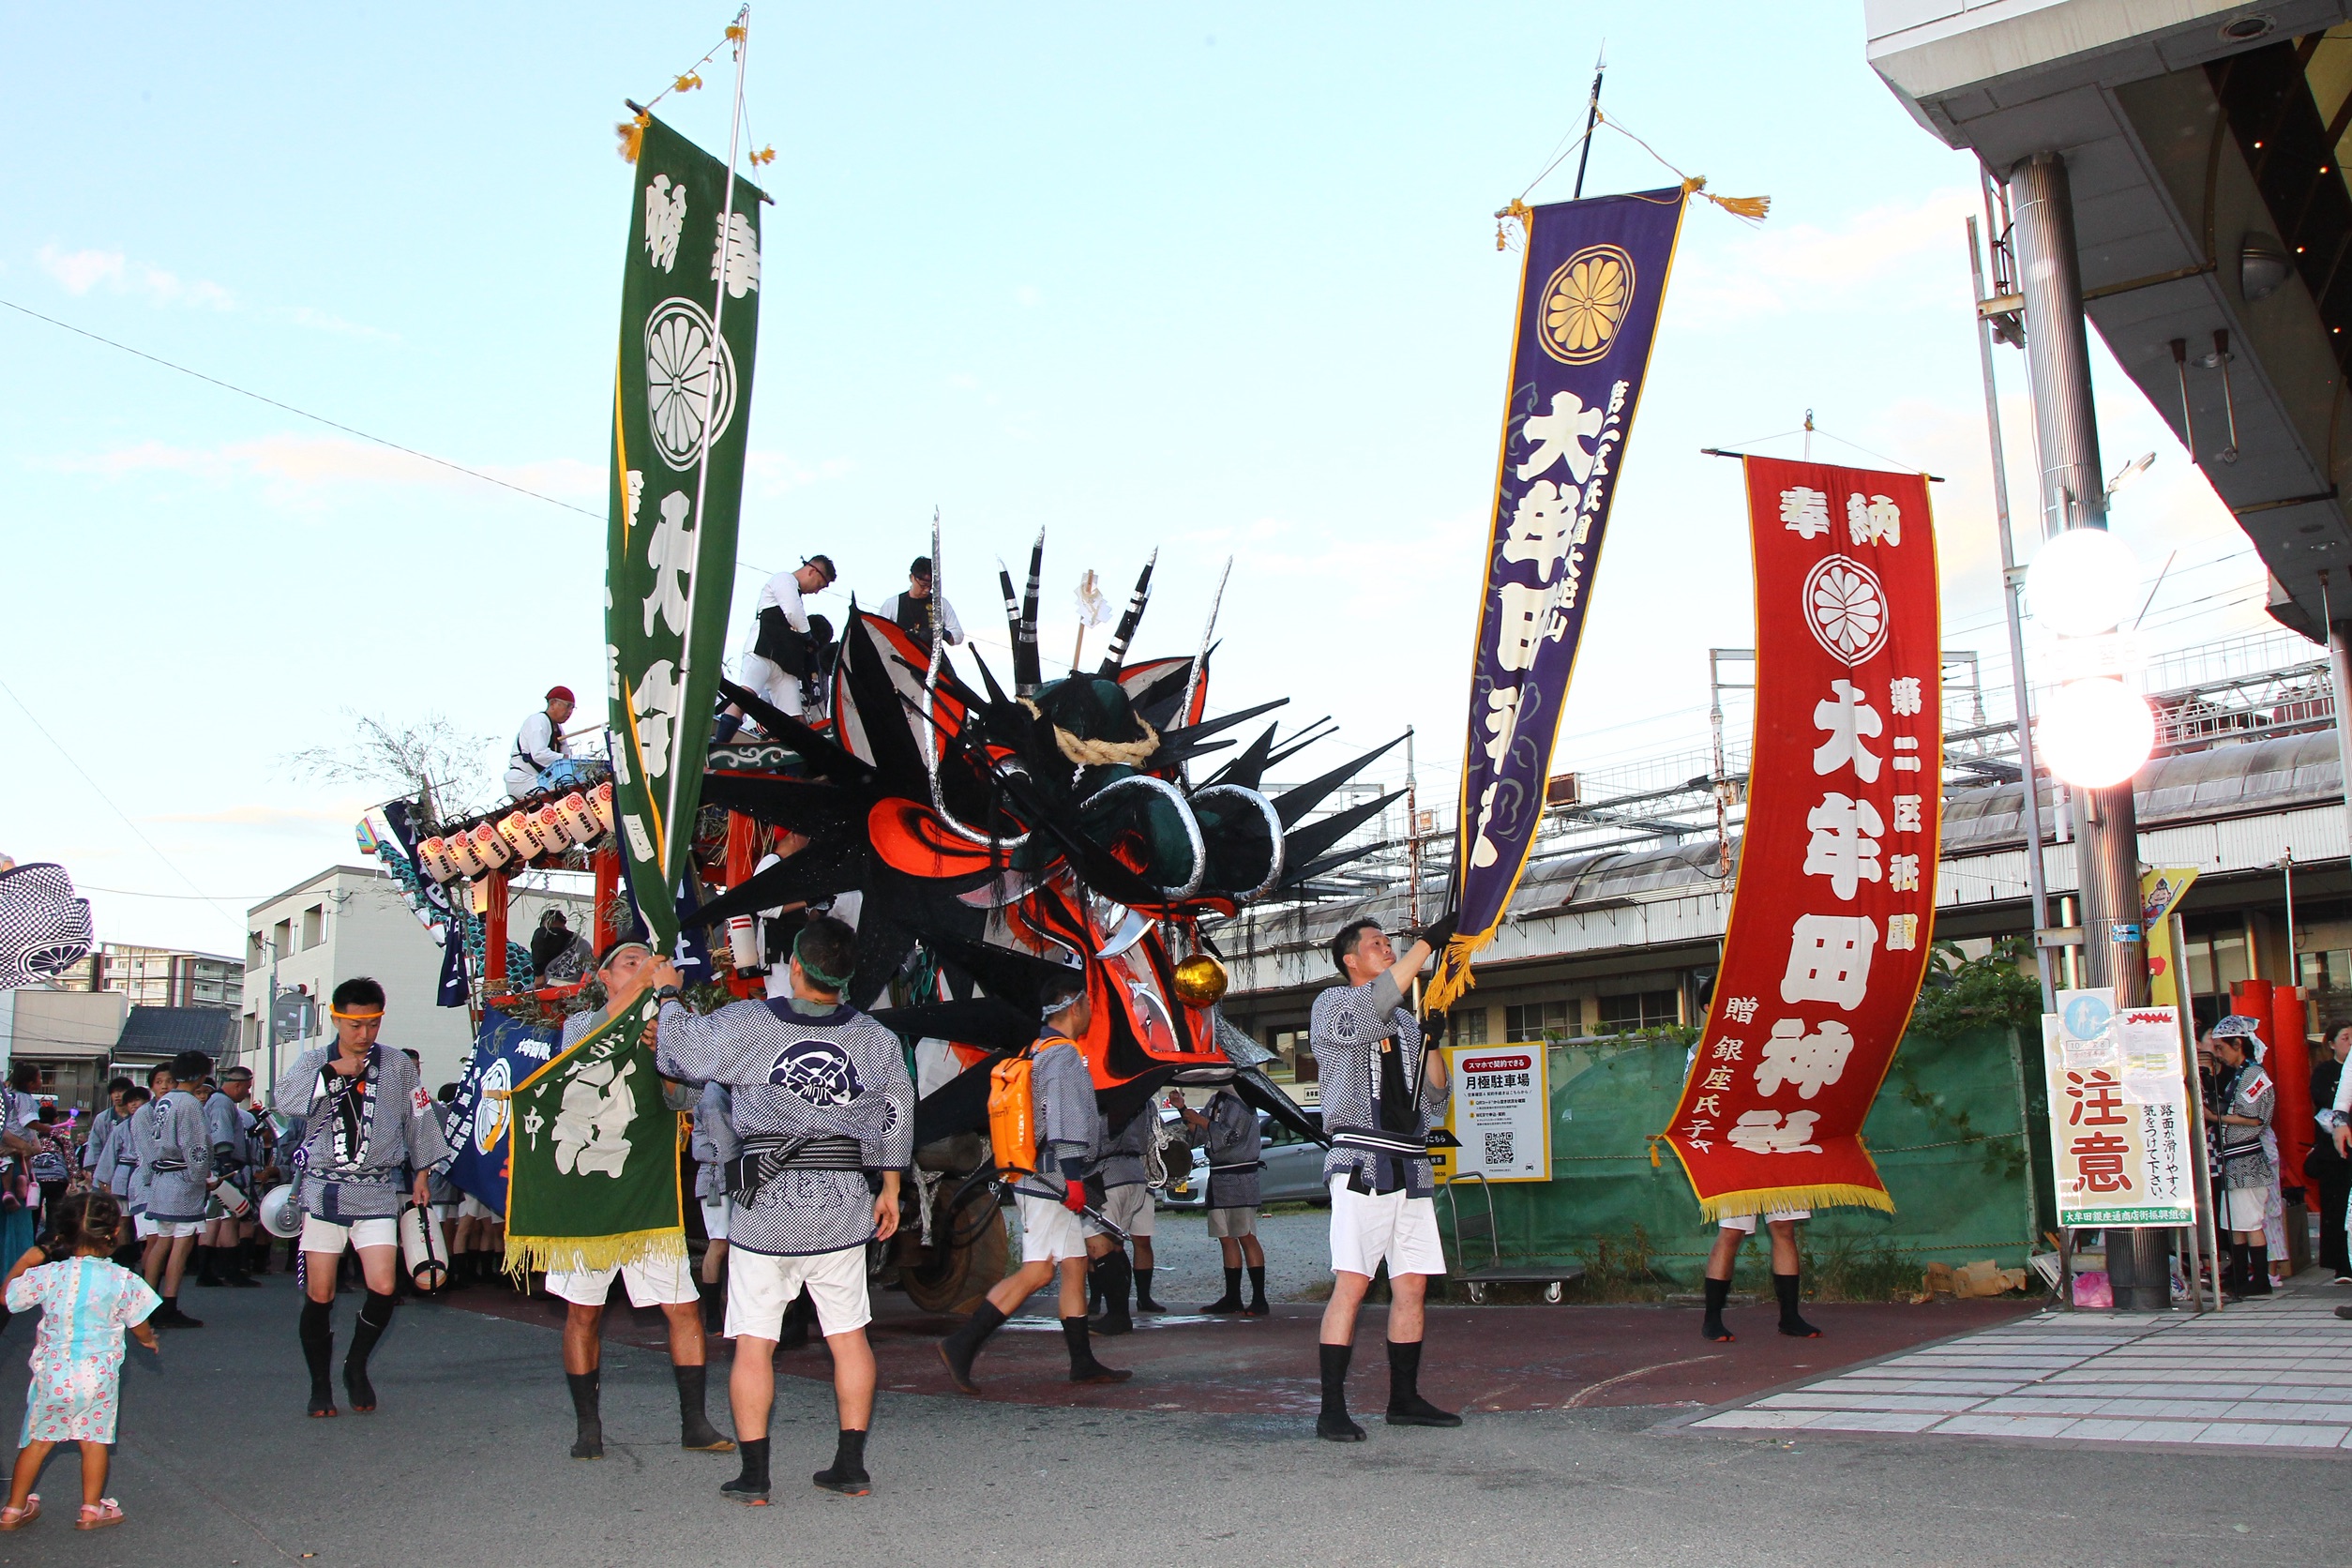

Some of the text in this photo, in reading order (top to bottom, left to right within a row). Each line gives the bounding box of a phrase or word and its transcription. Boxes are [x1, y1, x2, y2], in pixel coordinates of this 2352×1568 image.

[1779, 486, 1901, 547] 奉納
[1470, 390, 1605, 870] 大牟田
[1886, 676, 1922, 951] 第二区祇園
[1727, 678, 1886, 1154] 大牟田神社
[1466, 1073, 1530, 1090] 月極駐車場
[1469, 1059, 1525, 1069] スマホで契約できる
[1681, 996, 1759, 1154] 贈 銀座氏子中
[2065, 1069, 2133, 1193] 注意
[2143, 1105, 2164, 1199] 気をつけて下さい。
[2160, 1104, 2179, 1198] 路面が滑りやすく
[2066, 1210, 2189, 1222] 大牟田銀座通商店街振興組合
